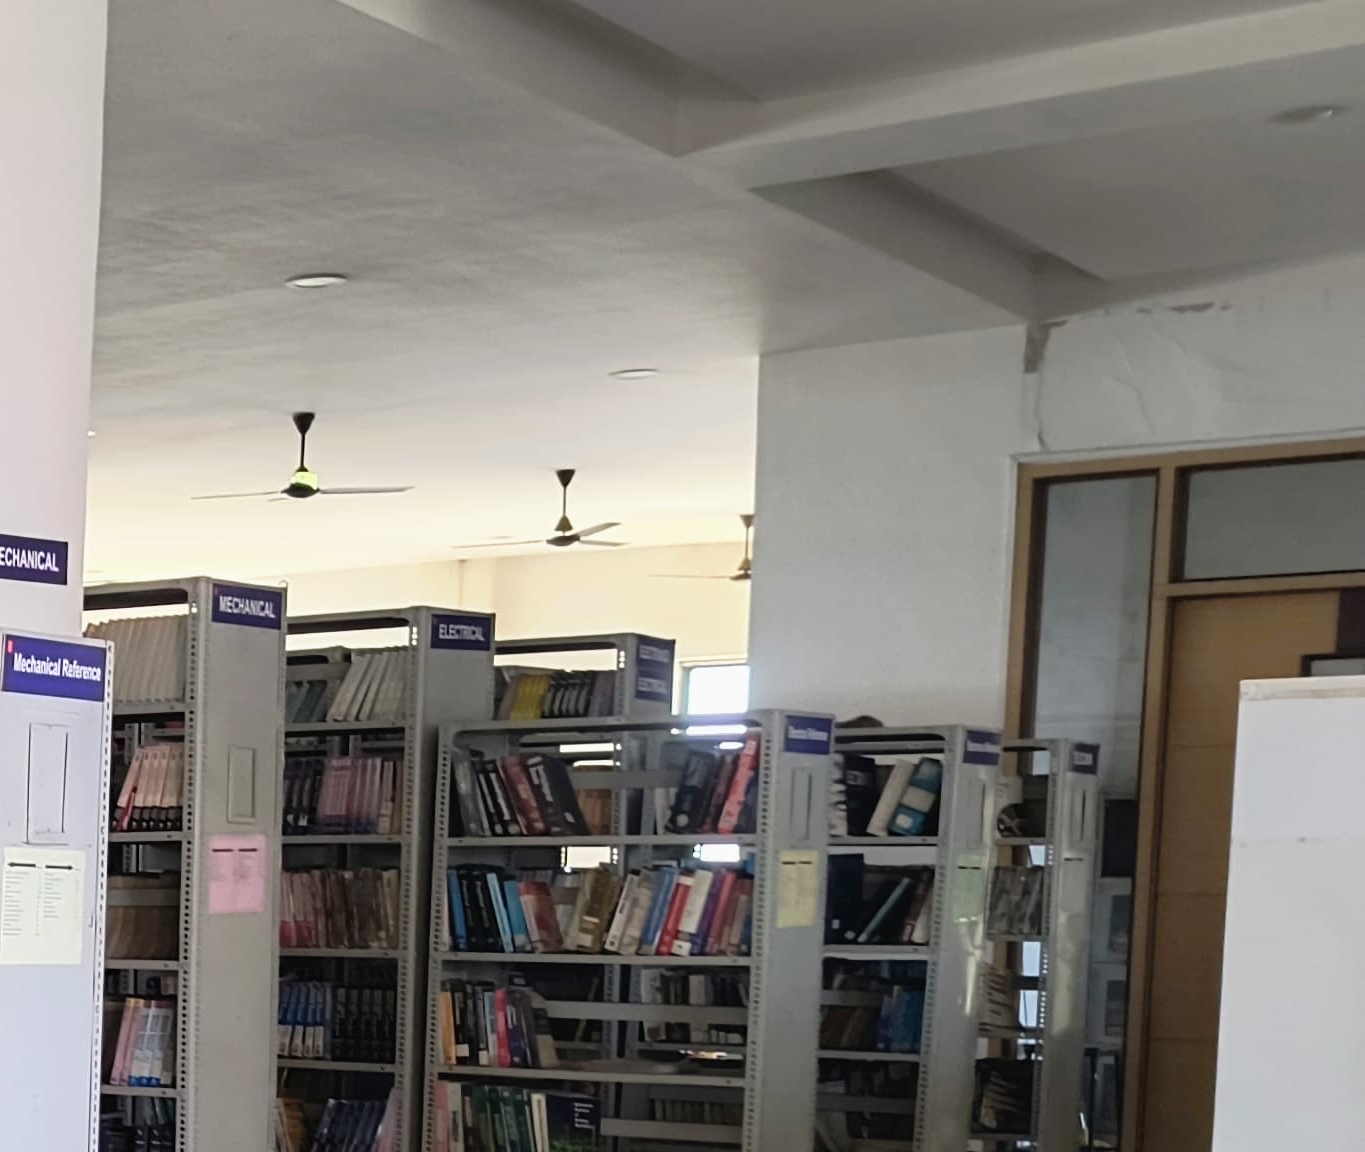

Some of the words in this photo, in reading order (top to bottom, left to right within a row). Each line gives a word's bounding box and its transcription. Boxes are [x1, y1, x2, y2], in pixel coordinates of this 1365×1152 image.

[219, 595, 276, 619] MECHANICAL
[13, 652, 61, 677] Mechanical
[62, 658, 102, 682] Reference
